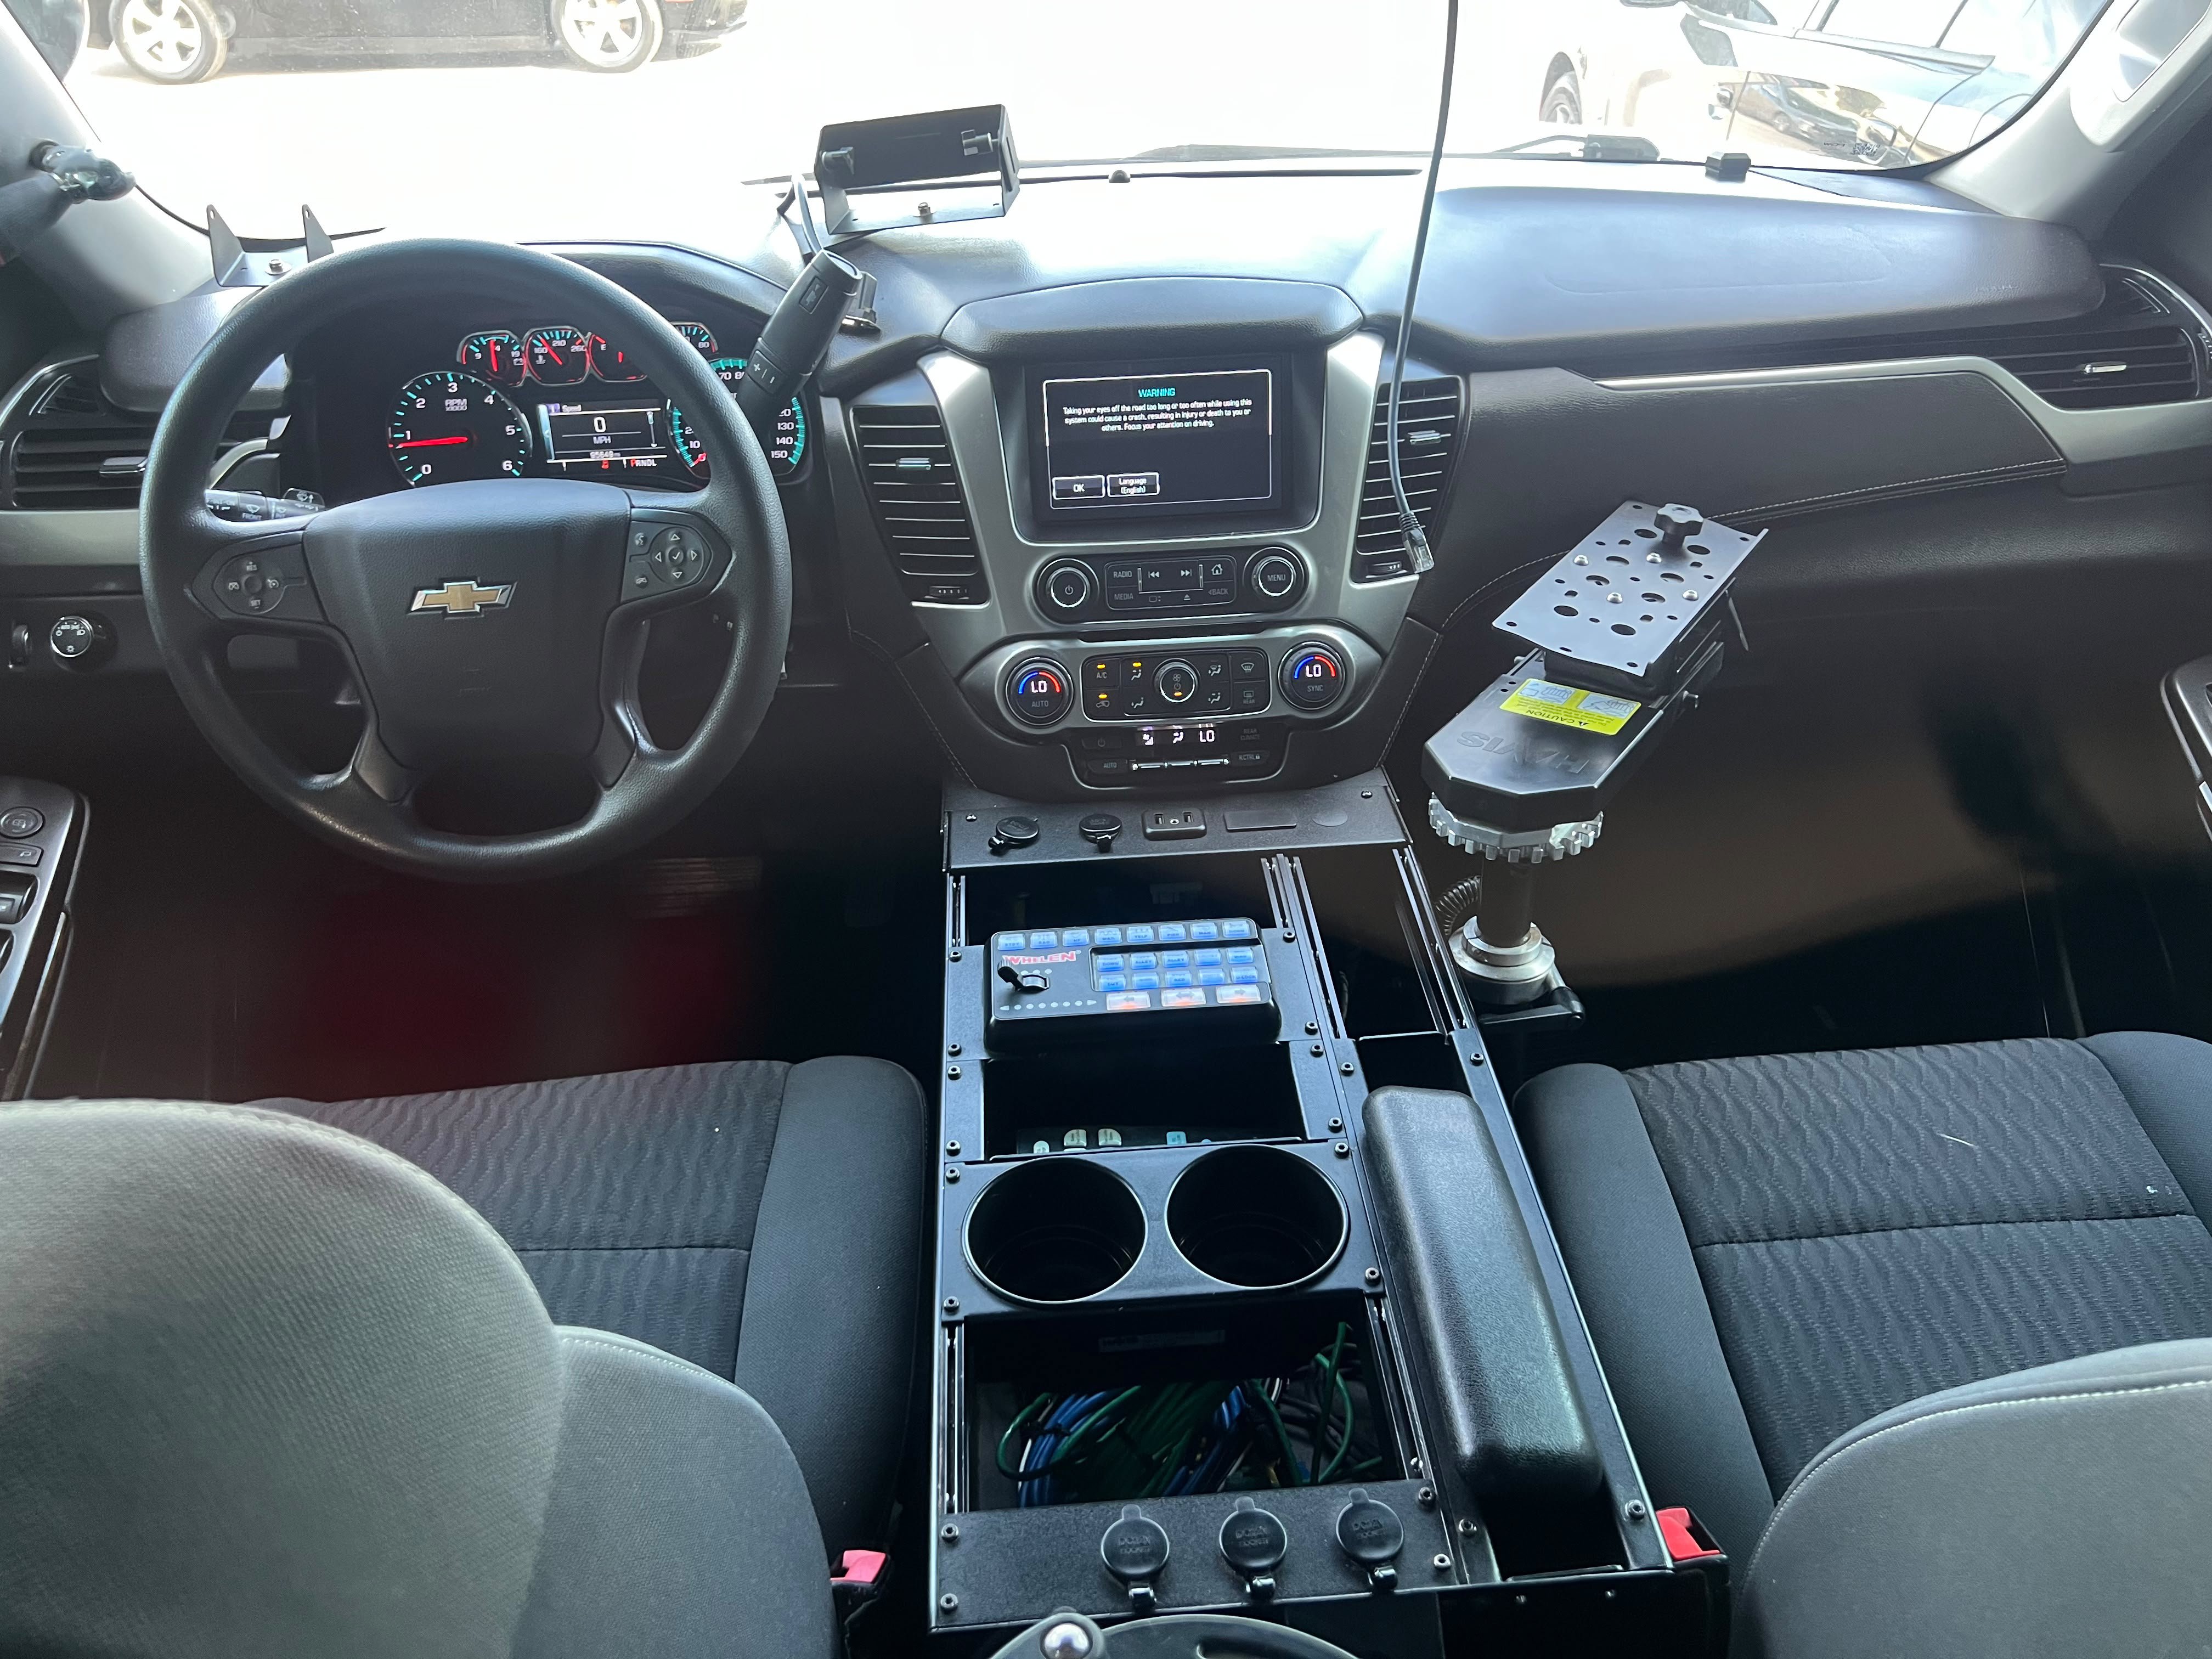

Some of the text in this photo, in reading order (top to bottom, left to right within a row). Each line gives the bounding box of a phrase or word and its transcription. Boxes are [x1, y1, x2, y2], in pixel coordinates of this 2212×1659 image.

[448, 382, 459, 393] 3
[1138, 387, 1175, 397] WARNING
[416, 398, 426, 409] 2
[445, 398, 467, 407] RPM
[484, 395, 494, 405] 4
[1063, 407, 1082, 415] Taking
[1132, 403, 1146, 411] road
[1223, 399, 1239, 408] using
[1148, 411, 1175, 421] resulting
[1182, 411, 1198, 419] injury
[505, 425, 516, 435] 5
[593, 416, 606, 433] 0
[1142, 422, 1156, 431] your
[1193, 419, 1215, 428] driving.
[405, 430, 411, 441] 1
[685, 426, 693, 435] 2
[689, 441, 700, 449] 10
[776, 437, 793, 445] 140
[771, 450, 788, 459] 150
[421, 464, 432, 475] 0
[502, 460, 513, 471] 6
[1073, 483, 1085, 492] OK
[1118, 478, 1147, 486] Language
[1120, 486, 1146, 495] (English)
[1306, 664, 1322, 678] LO
[1031, 680, 1047, 693] LO
[1526, 709, 1575, 724] CAUTION
[1199, 730, 1215, 742] LO
[1003, 951, 1076, 965] WHELEN
